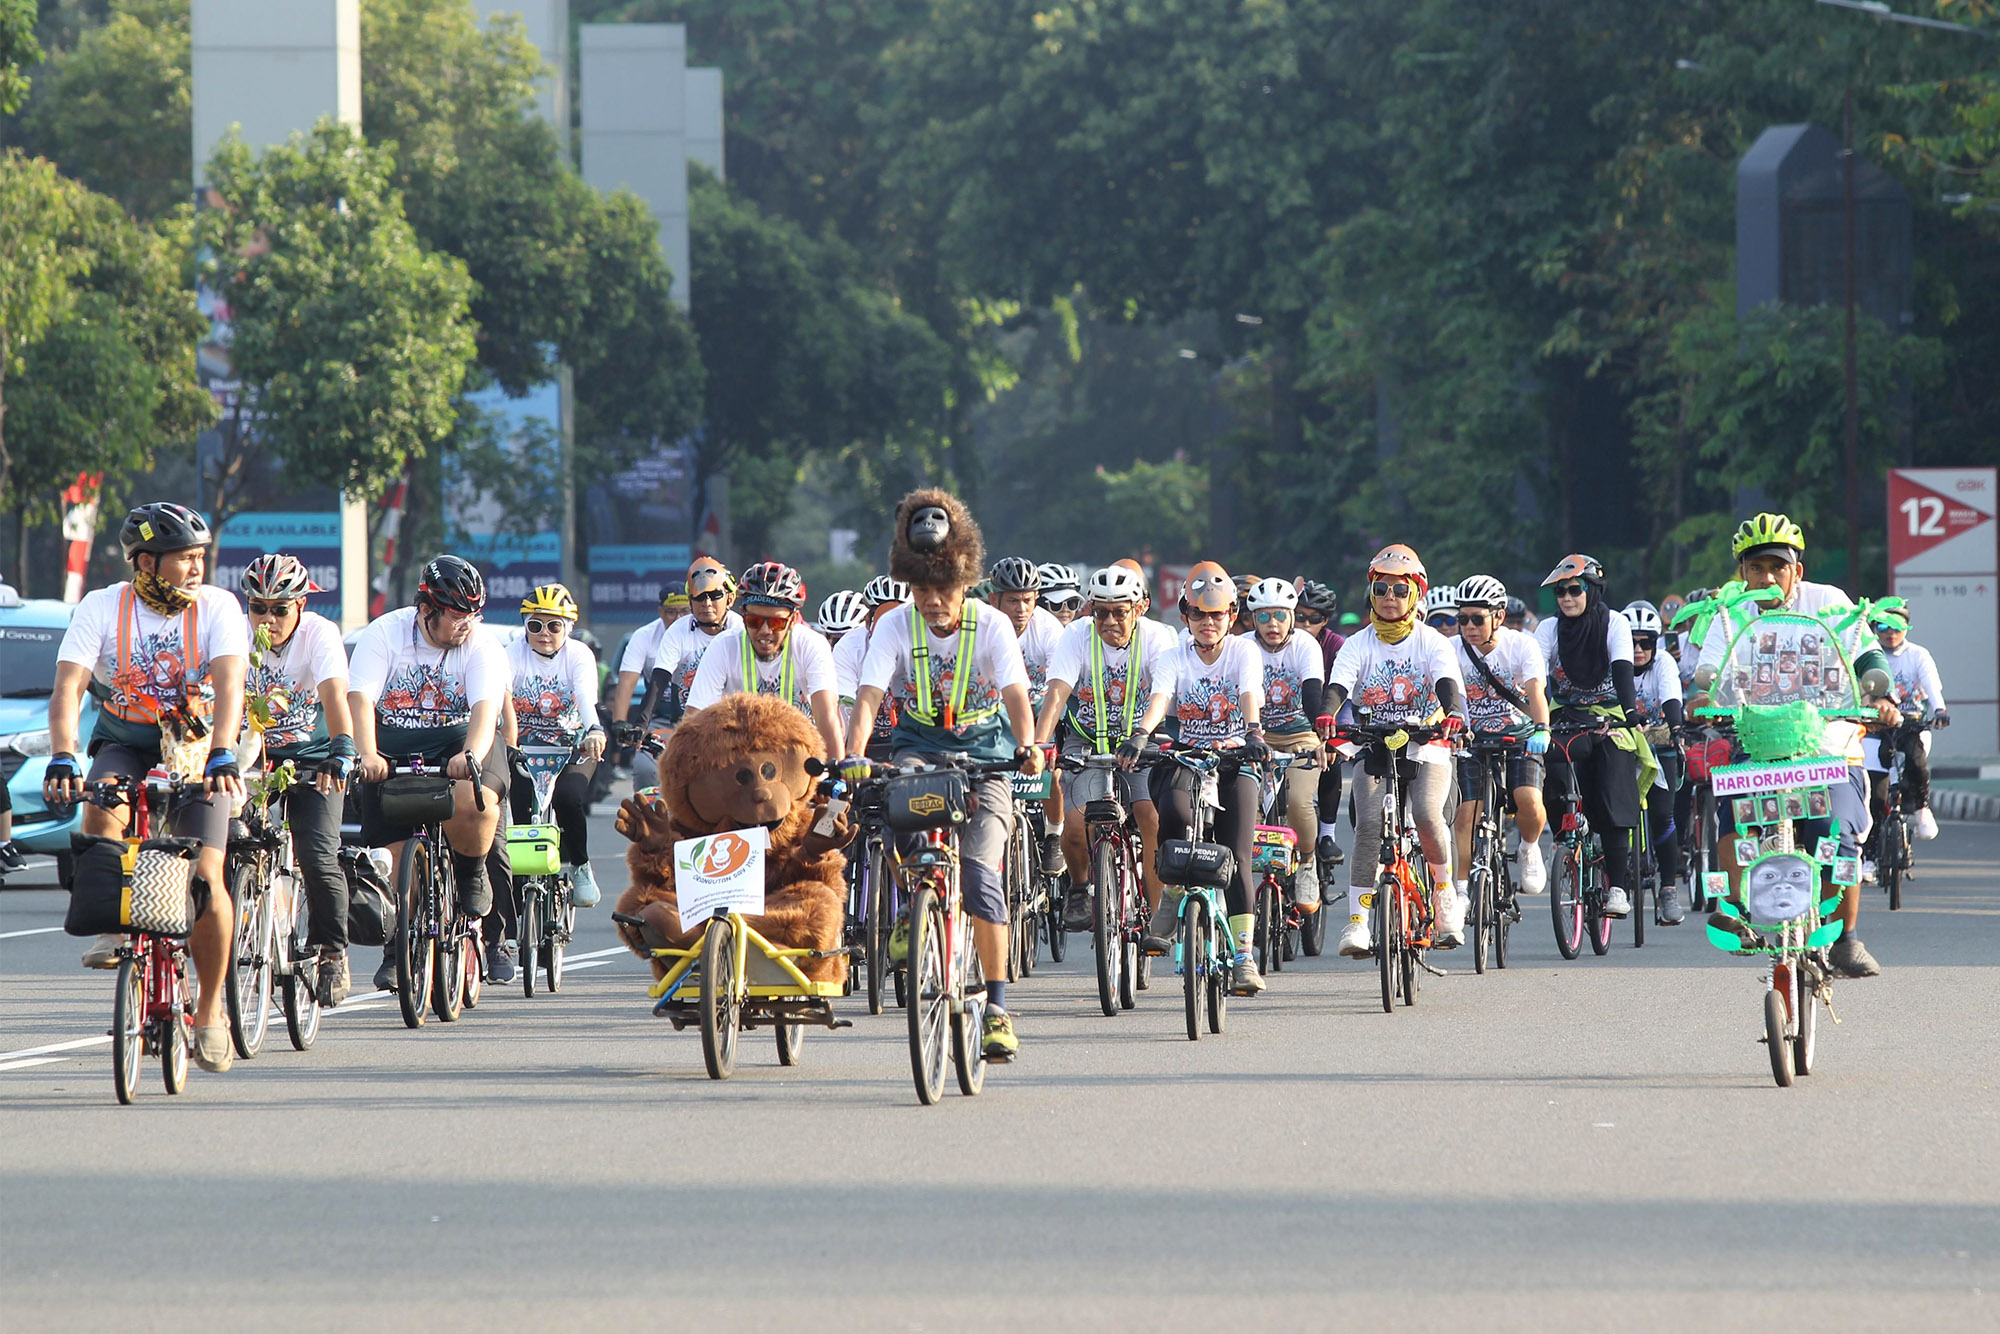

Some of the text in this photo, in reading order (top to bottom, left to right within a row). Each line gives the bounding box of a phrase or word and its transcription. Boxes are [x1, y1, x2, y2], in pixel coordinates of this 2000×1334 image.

[1900, 496, 1946, 536] 12
[221, 524, 337, 535] ACE AVAILABLE
[6, 630, 52, 642] Group
[1782, 692, 1800, 702] FOR
[1088, 701, 1110, 711] LOE
[1372, 702, 1395, 711] LOVE
[395, 708, 420, 717] LOVE
[1716, 776, 1750, 791] HARI
[1808, 766, 1847, 781] UTAN
[1010, 783, 1043, 794] GUTAN
[733, 868, 746, 878] DAY
